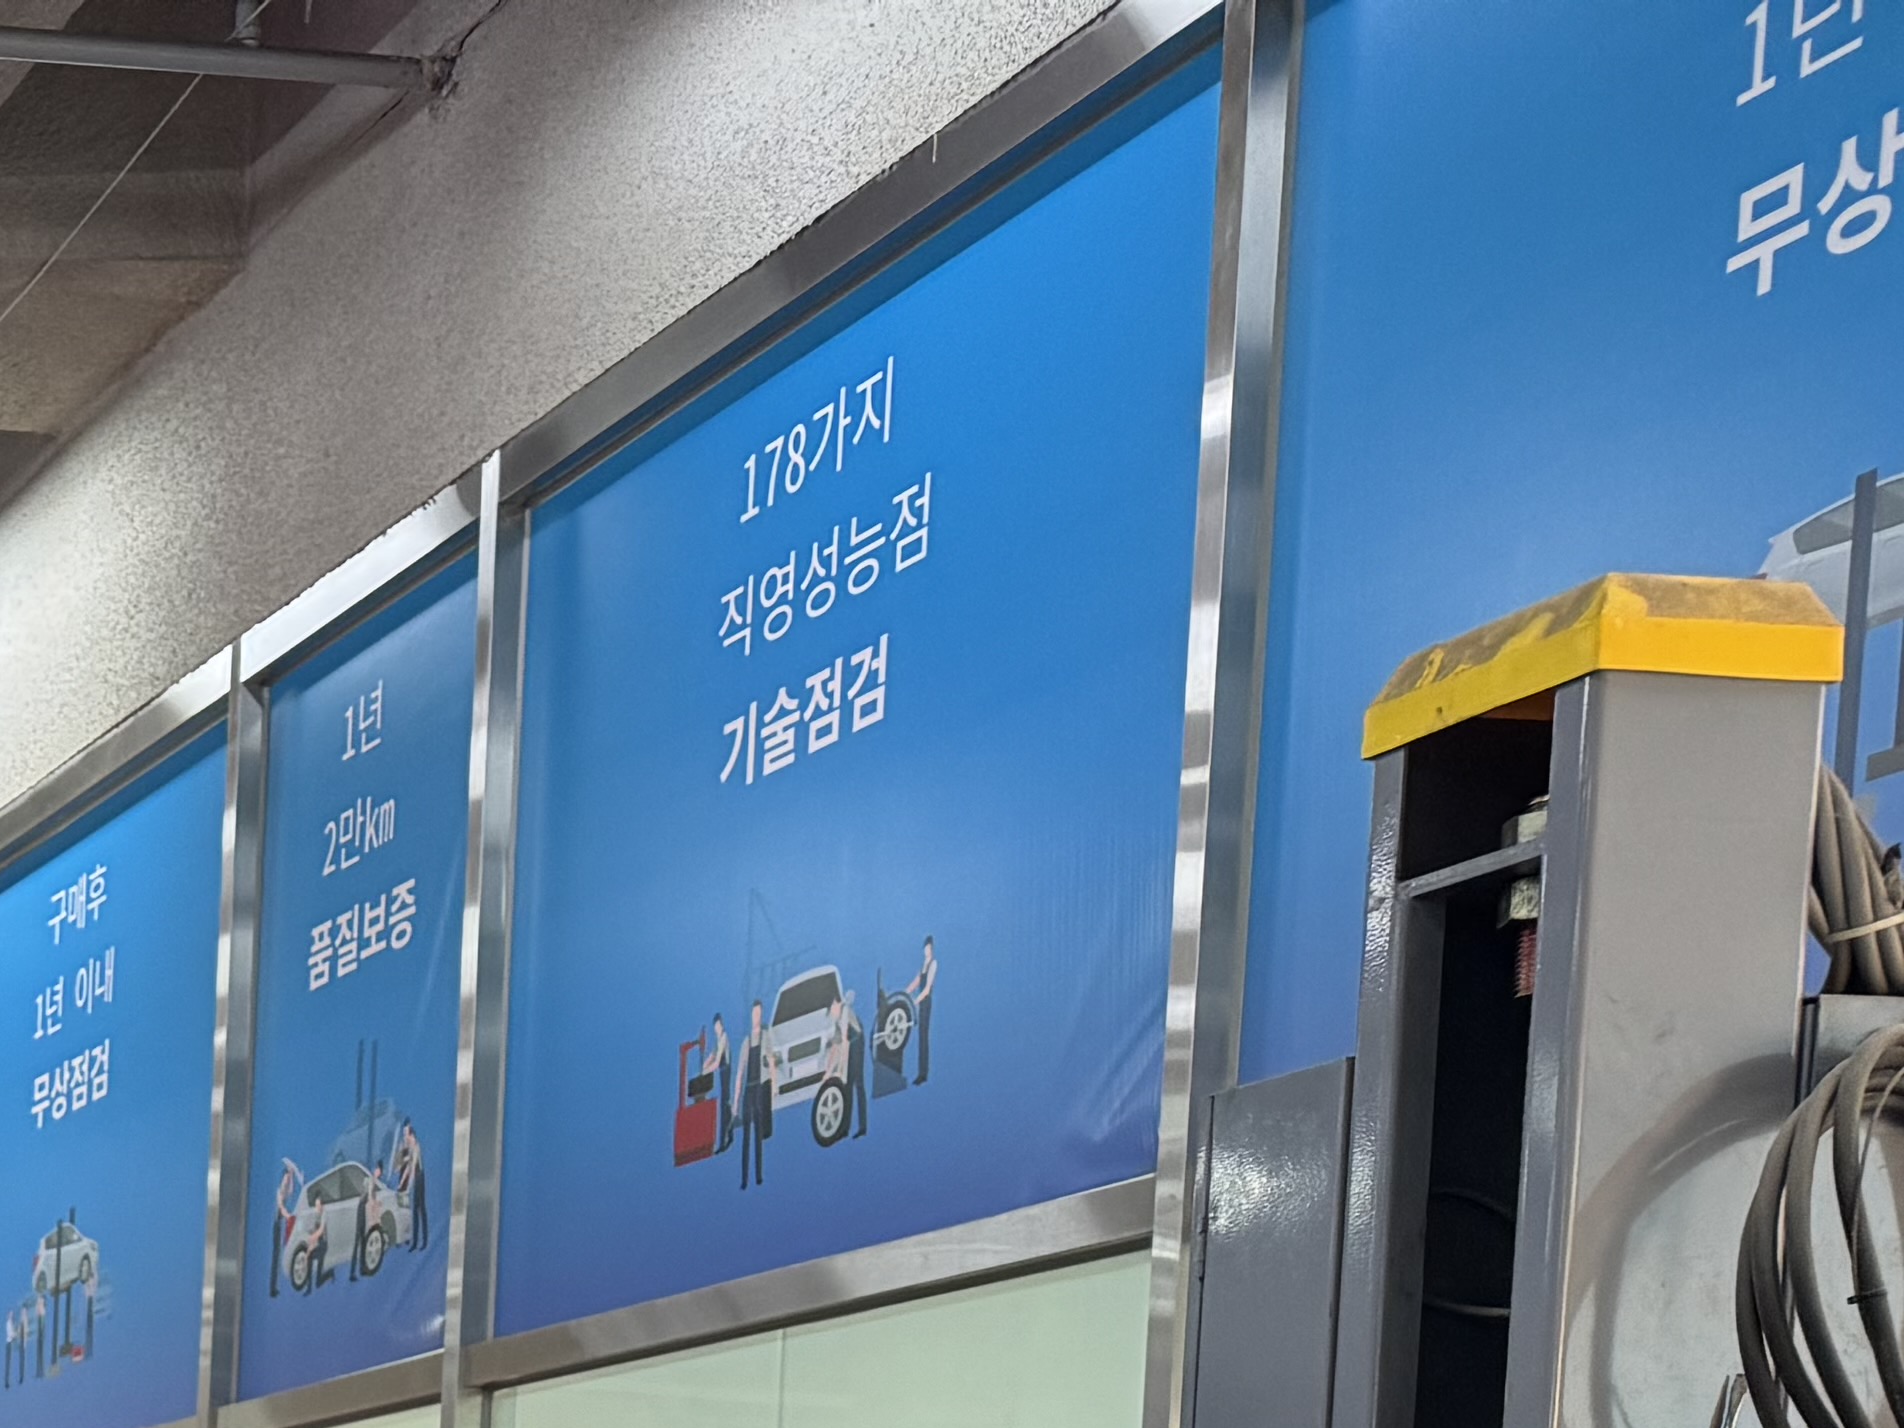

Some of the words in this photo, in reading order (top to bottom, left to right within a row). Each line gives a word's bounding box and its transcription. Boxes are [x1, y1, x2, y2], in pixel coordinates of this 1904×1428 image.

[740, 355, 895, 526] 178가지
[718, 470, 933, 658] 직영성능점
[341, 680, 383, 761] 1년
[718, 633, 889, 786] 기술점검
[322, 795, 396, 878] 2만km
[47, 863, 109, 946] 구매후
[307, 878, 417, 992] 품질보증
[32, 975, 65, 1040] 1년
[74, 947, 114, 1015] 이내
[30, 1037, 110, 1130] 무상점검
